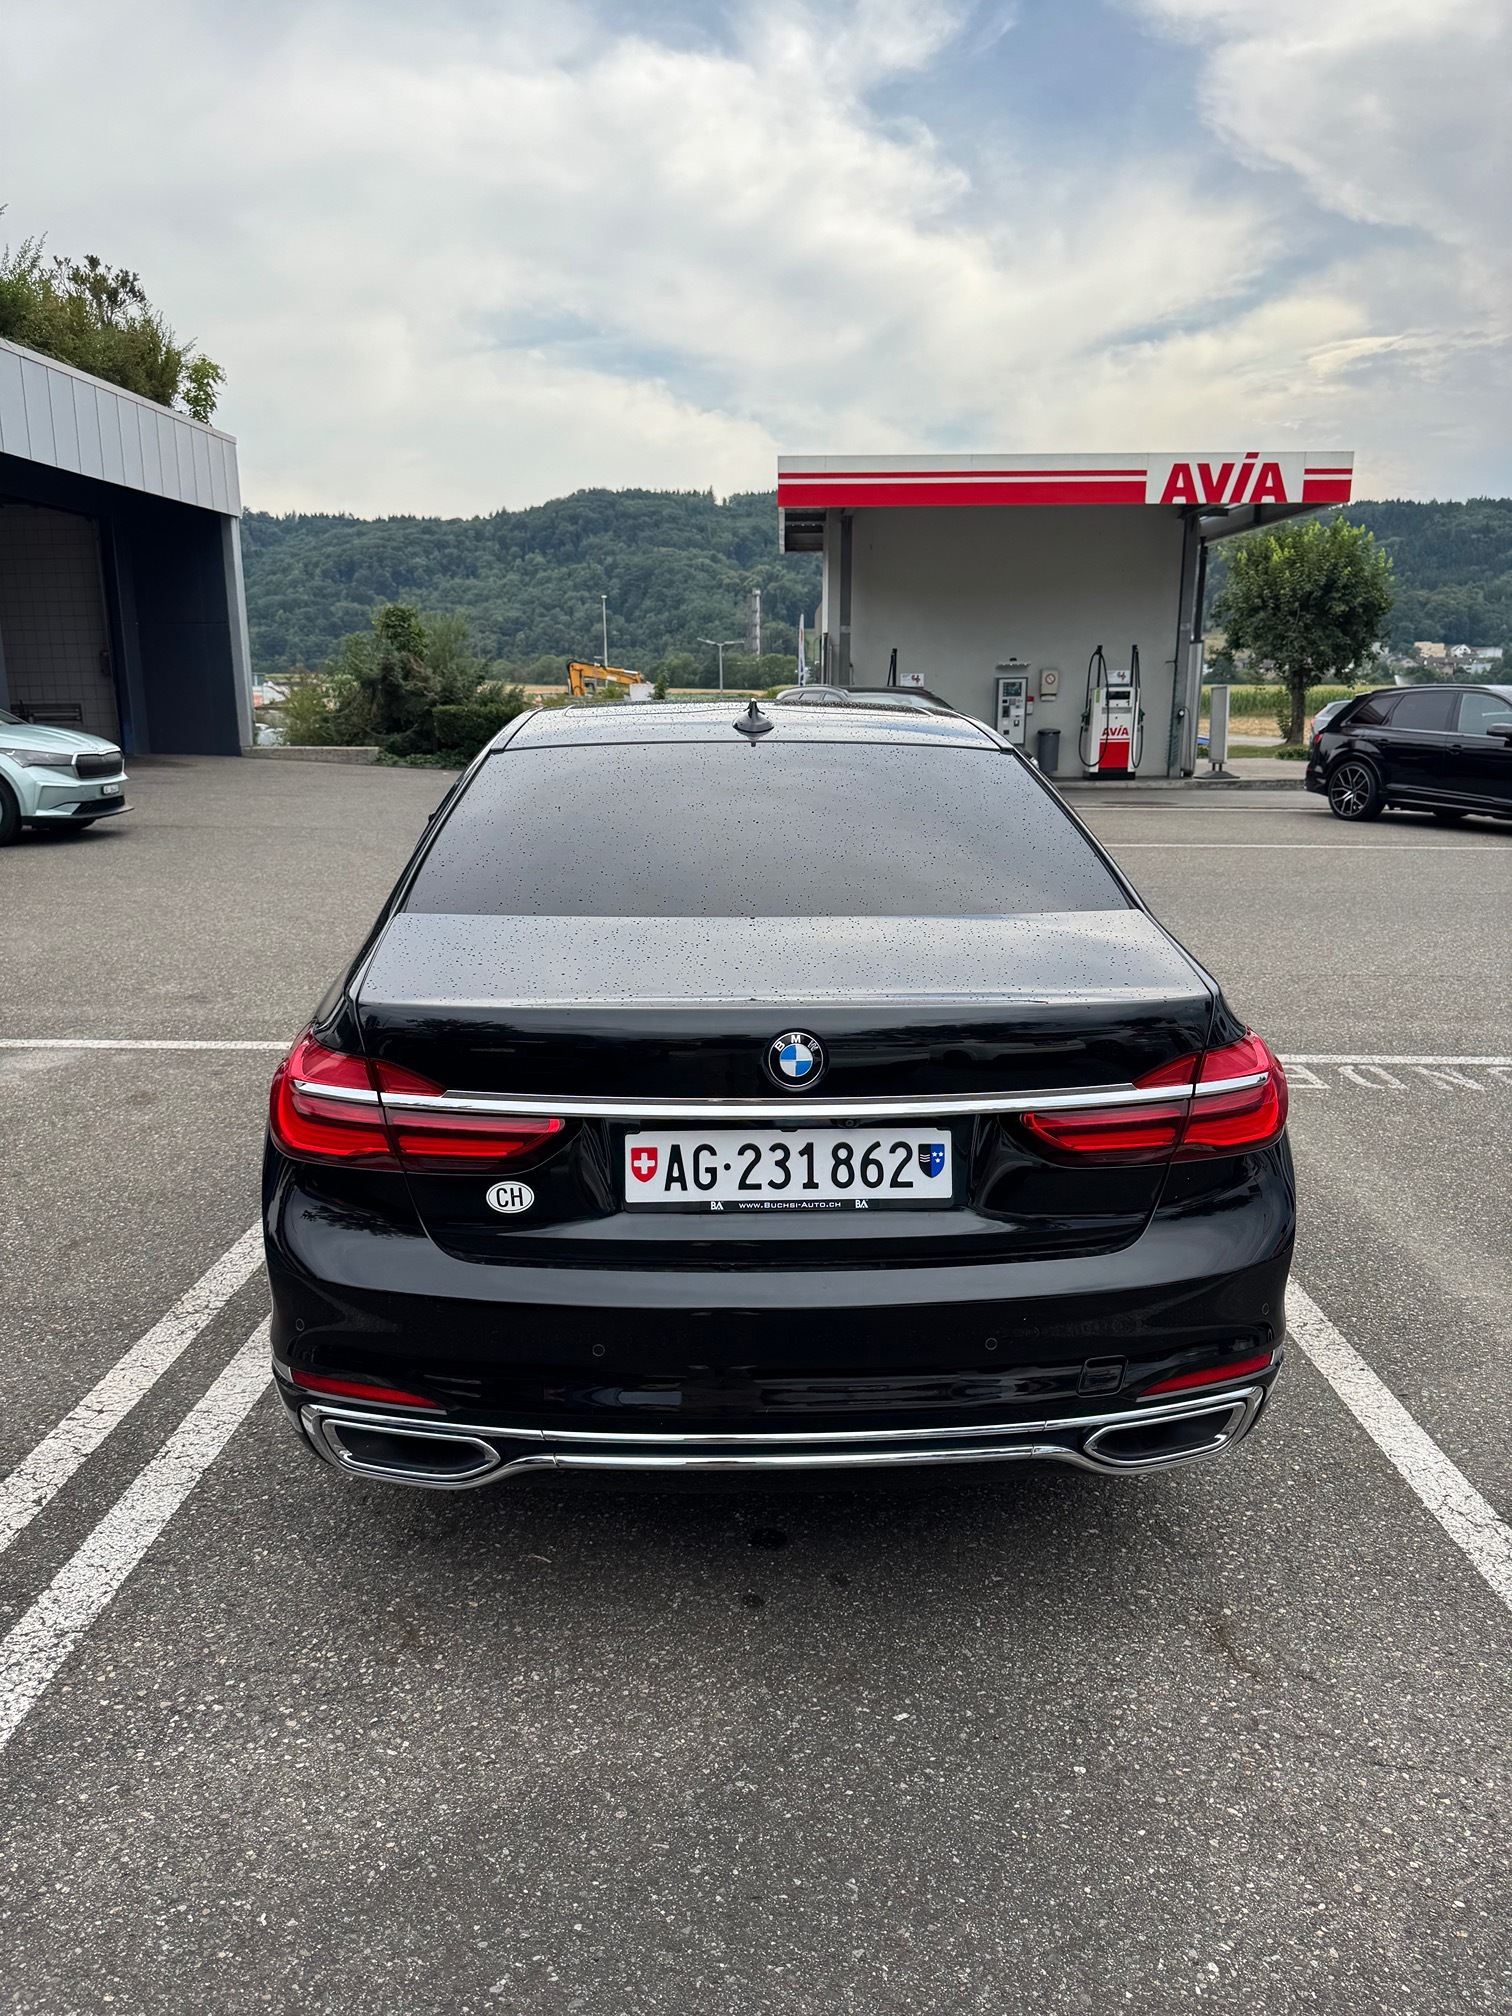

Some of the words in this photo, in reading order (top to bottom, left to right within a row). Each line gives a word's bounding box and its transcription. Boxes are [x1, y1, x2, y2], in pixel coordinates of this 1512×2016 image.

[1159, 451, 1288, 504] AVIA
[1101, 725, 1129, 737] AVIA
[774, 1034, 819, 1052] BMW
[496, 1187, 523, 1208] CH
